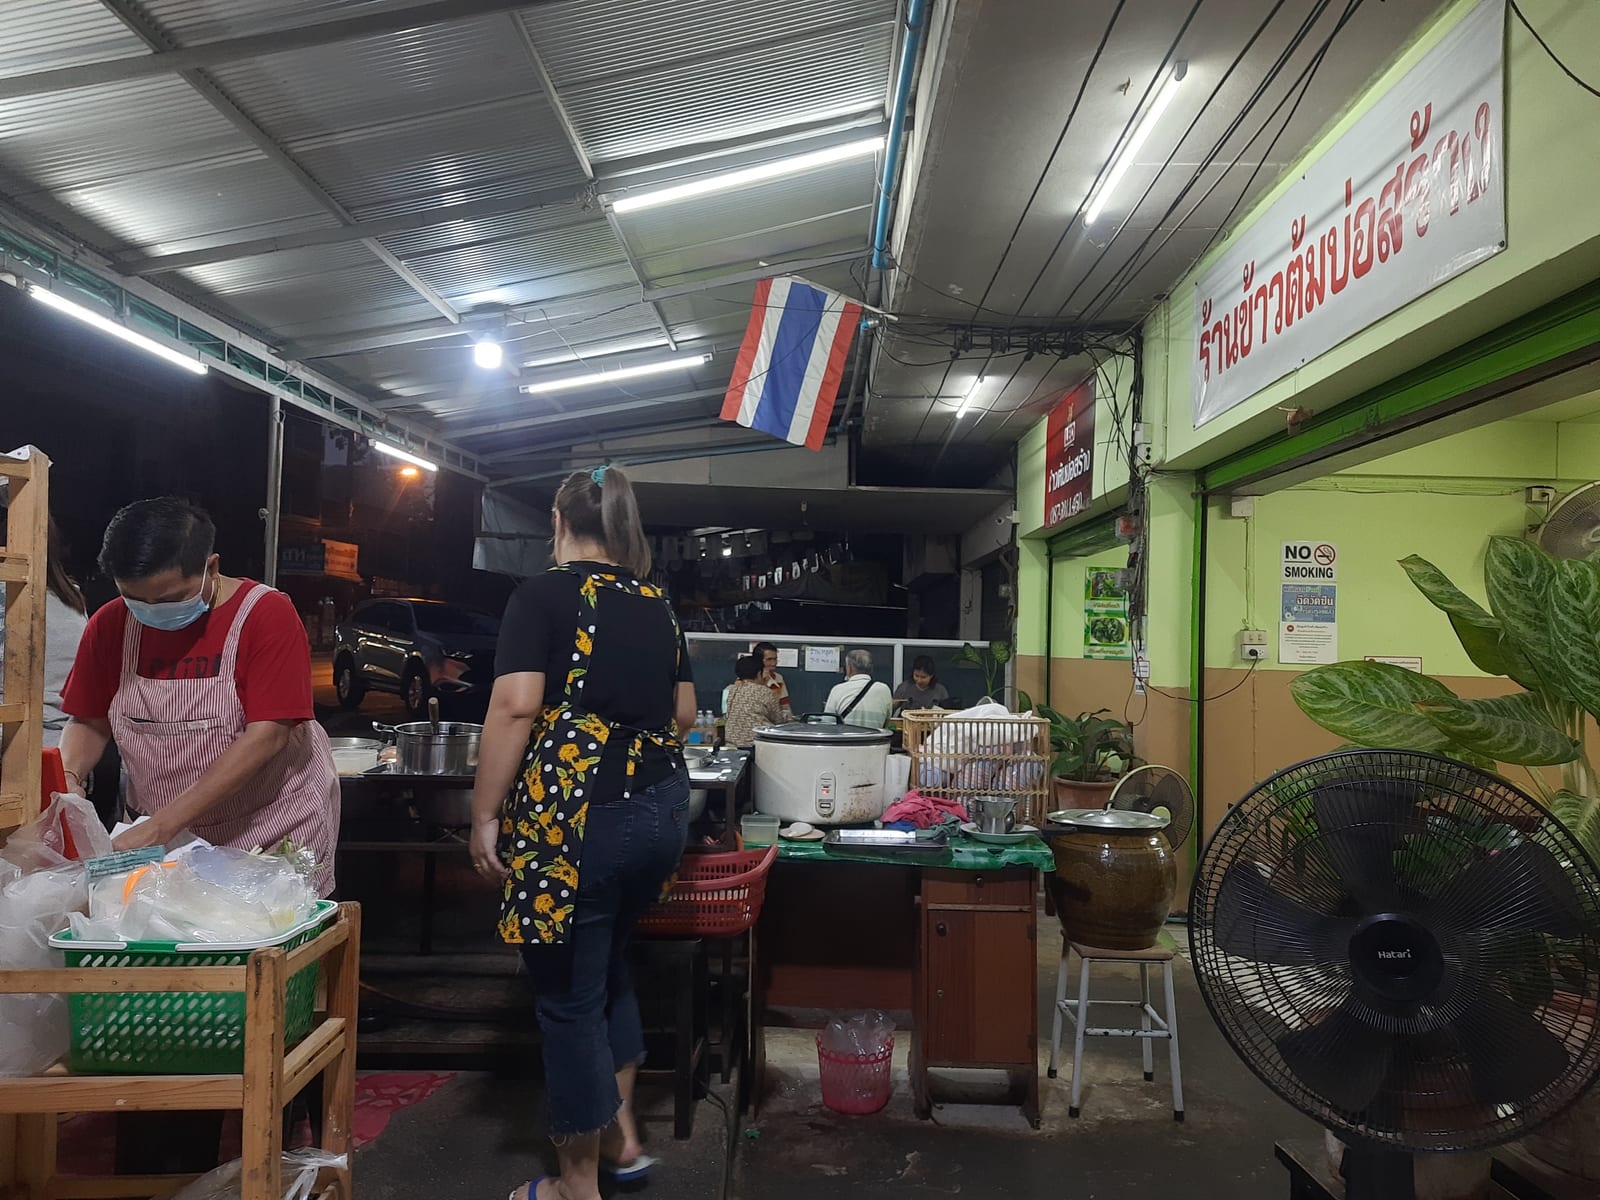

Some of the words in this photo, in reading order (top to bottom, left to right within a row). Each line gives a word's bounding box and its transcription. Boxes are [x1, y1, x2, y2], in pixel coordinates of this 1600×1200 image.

[1200, 101, 1491, 384] ร้านข้าวต้มบ่อสร้าง
[1285, 545, 1311, 560] NO
[1284, 566, 1334, 578] SMOKING
[1377, 948, 1412, 959] Hatari
